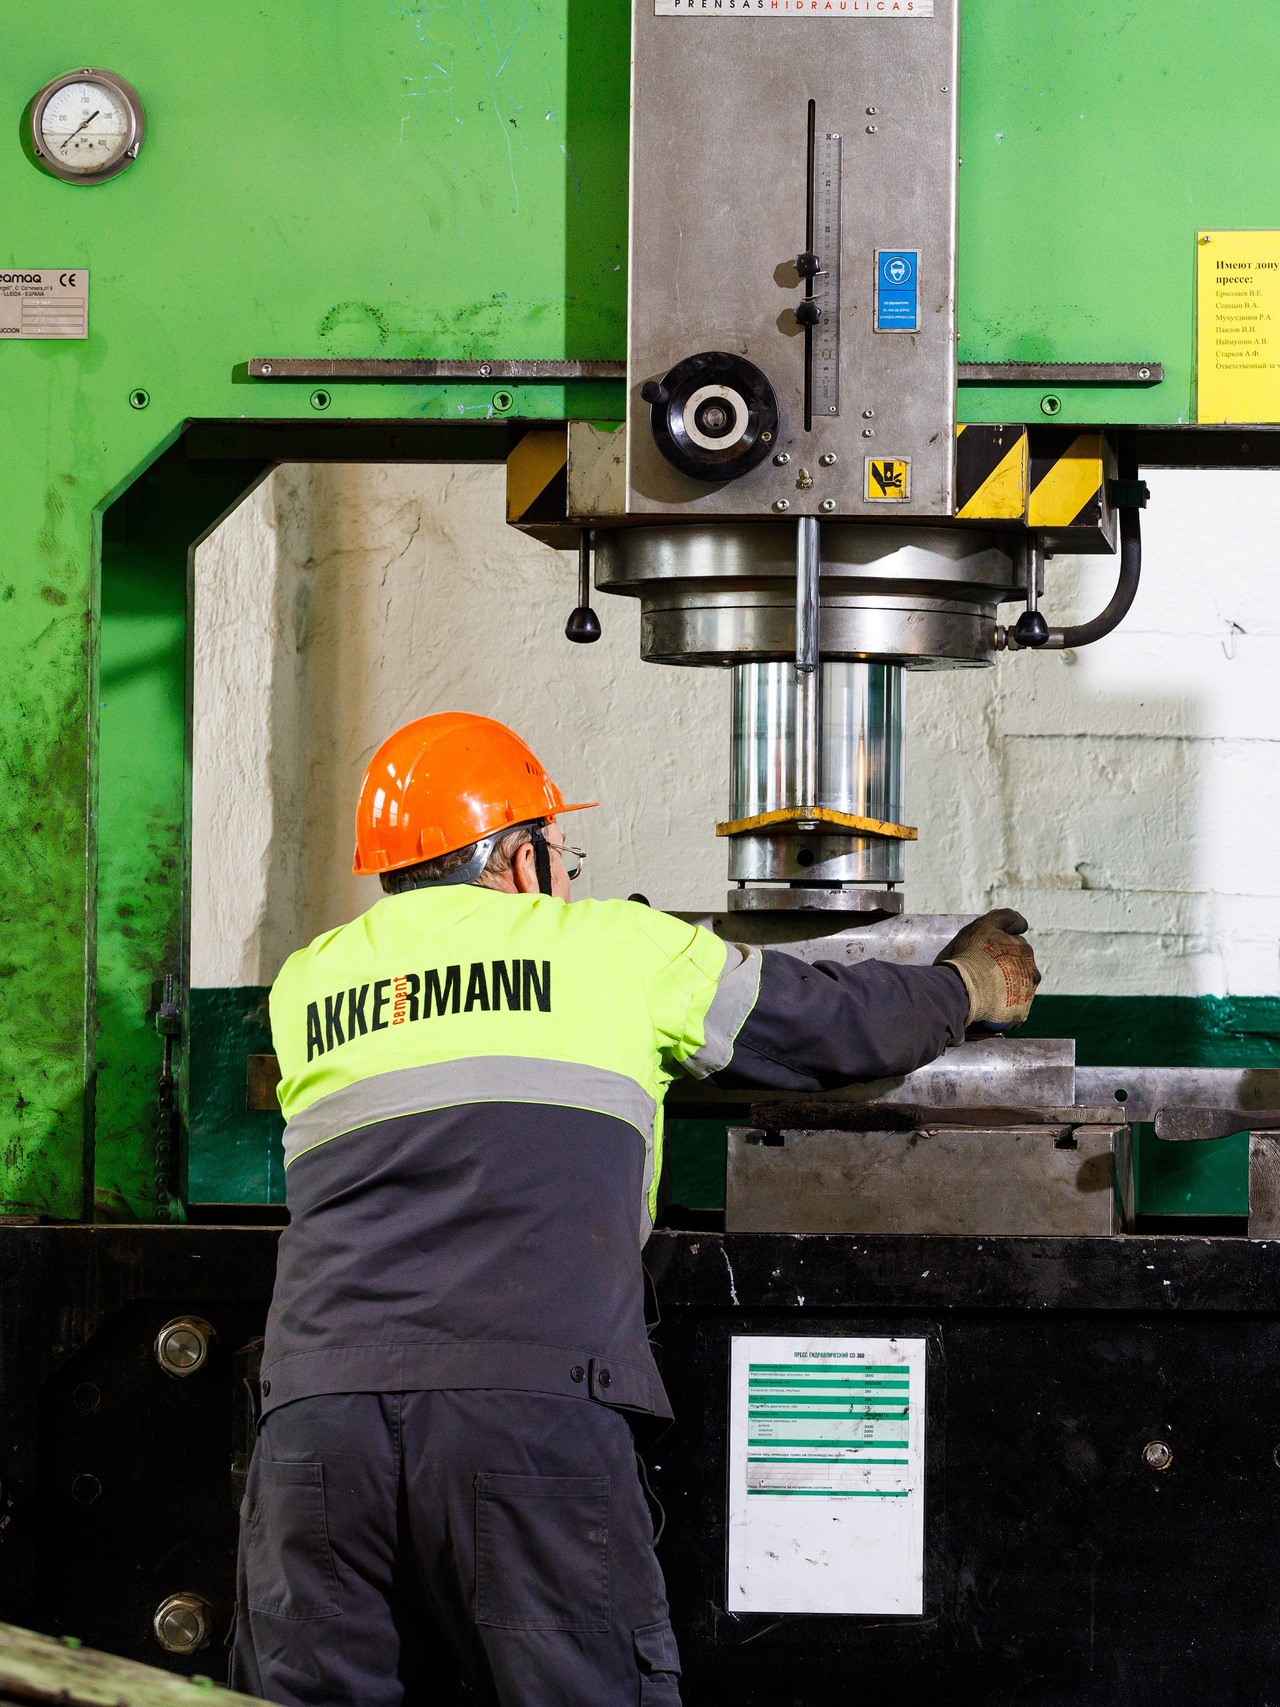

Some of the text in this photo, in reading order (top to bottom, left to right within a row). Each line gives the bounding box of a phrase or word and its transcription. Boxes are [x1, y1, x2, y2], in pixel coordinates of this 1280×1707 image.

[1216, 261, 1252, 269] Имеют
[1216, 276, 1253, 286] прессе:
[392, 974, 407, 1026] cement
[307, 959, 551, 1063] AKKERMANN
[809, 1351, 849, 1359] ГИДРАВЛИЧЕСКИЙ
